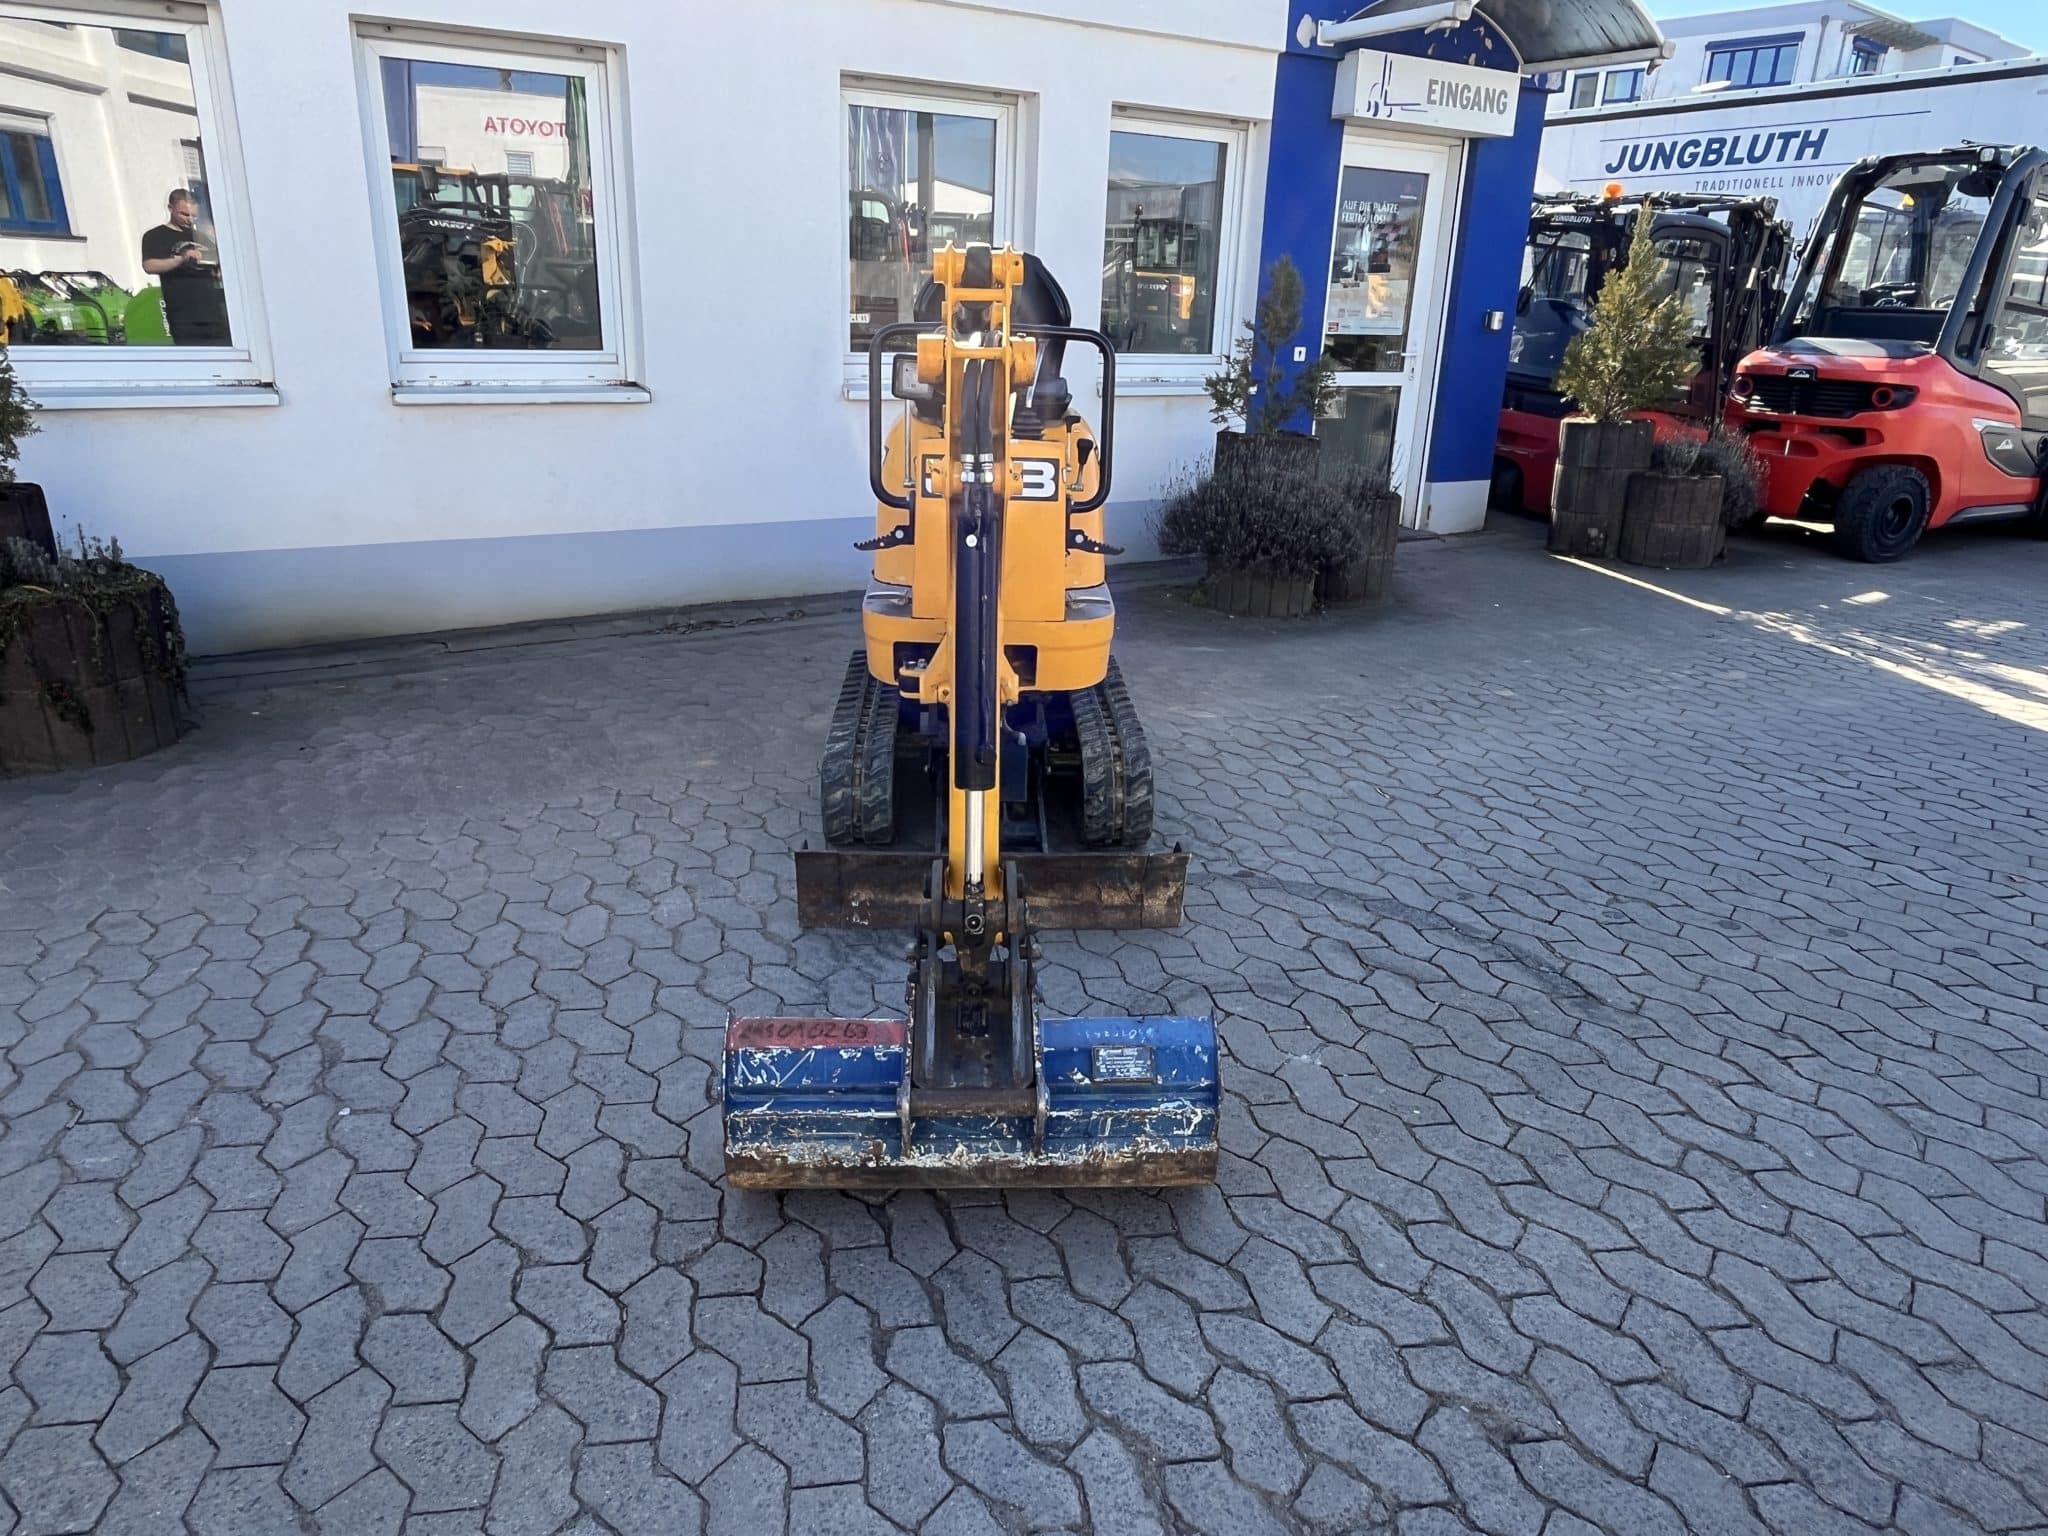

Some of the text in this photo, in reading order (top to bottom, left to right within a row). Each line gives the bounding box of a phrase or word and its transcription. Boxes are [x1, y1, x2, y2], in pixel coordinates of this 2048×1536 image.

[1427, 79, 1508, 115] EINGANG
[1605, 128, 1829, 174] JUNGBLUTH
[1695, 176, 1784, 192] TRADITIONELL
[1343, 200, 1358, 211] AUF
[1359, 201, 1372, 213] DIE
